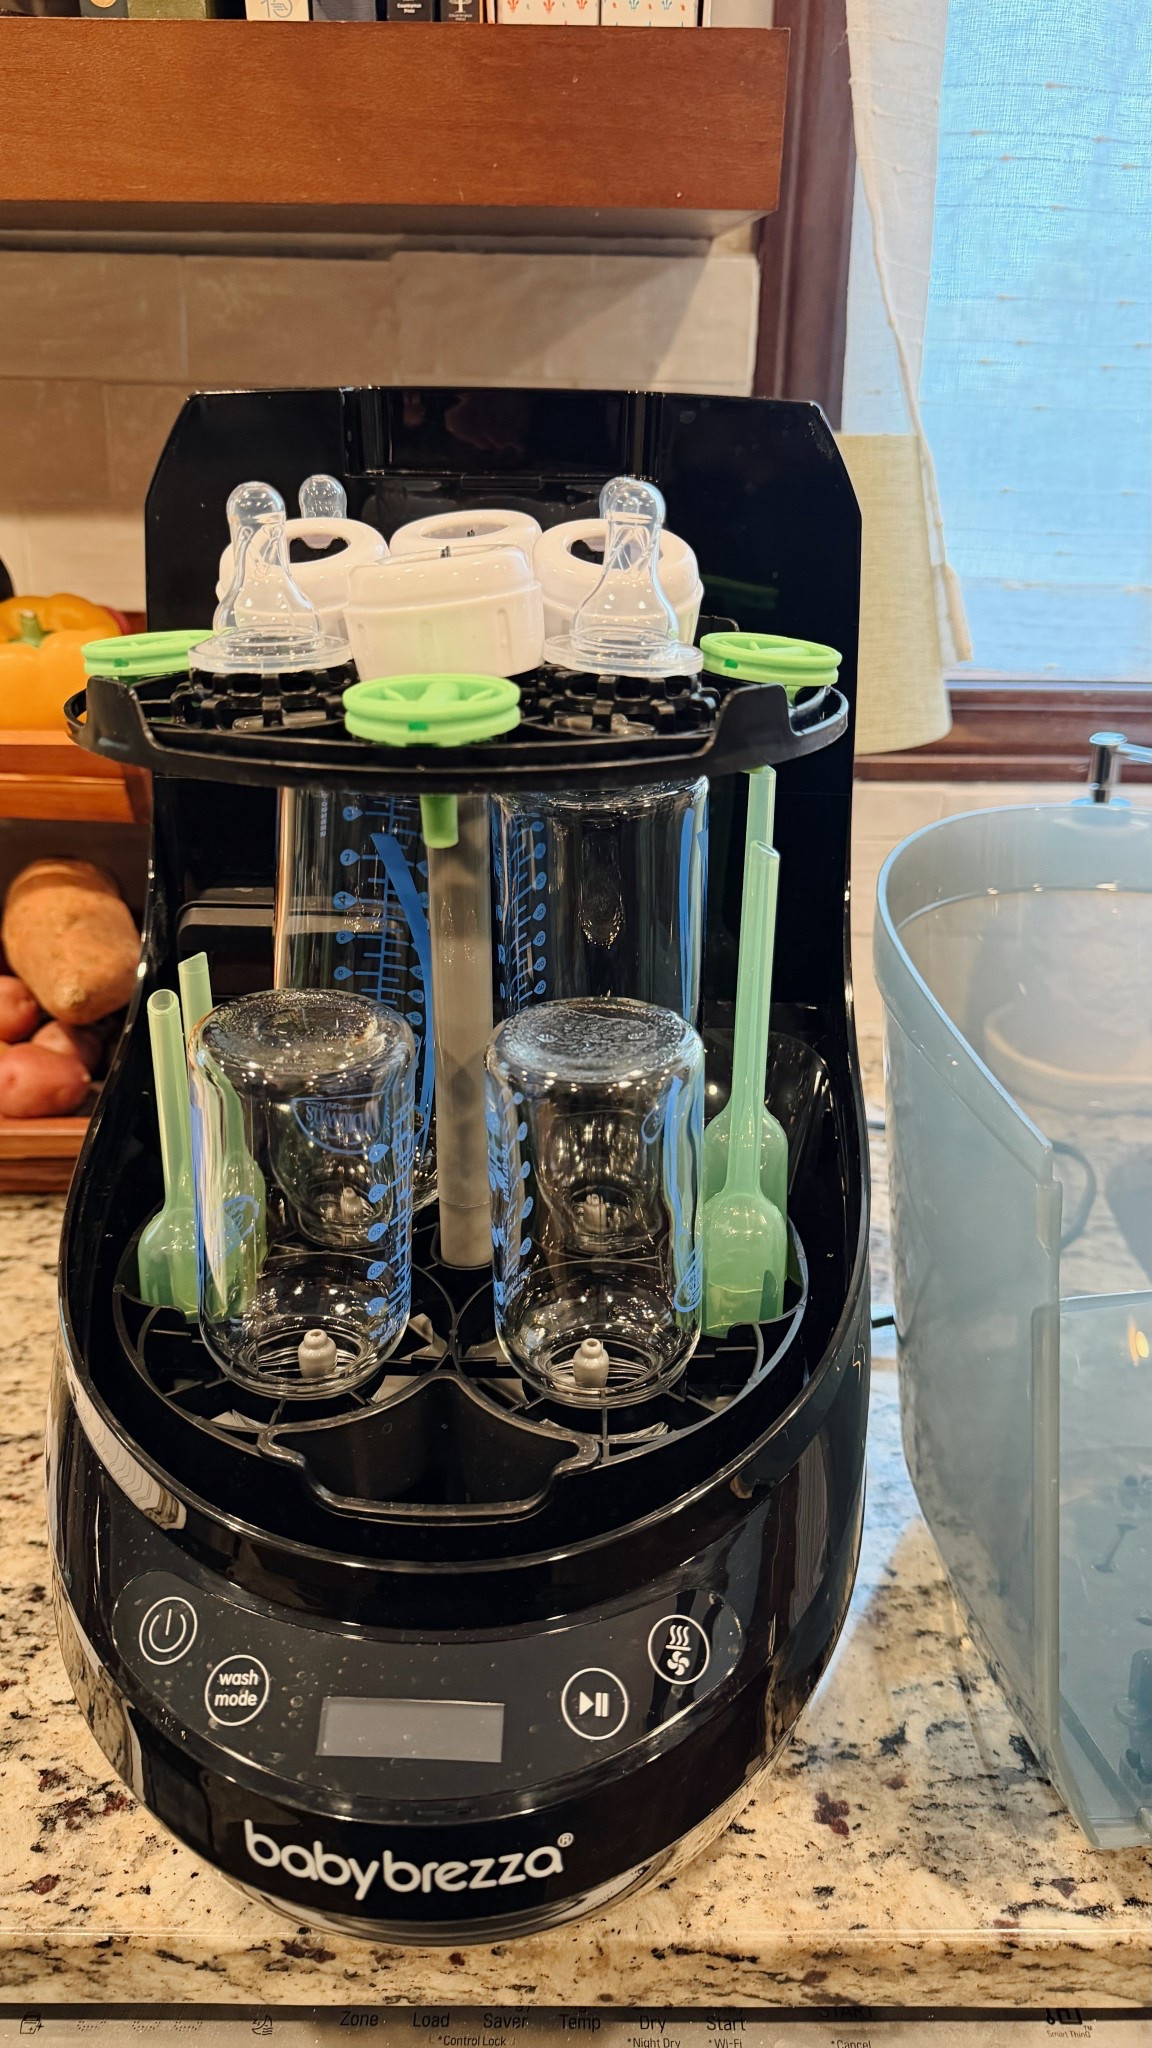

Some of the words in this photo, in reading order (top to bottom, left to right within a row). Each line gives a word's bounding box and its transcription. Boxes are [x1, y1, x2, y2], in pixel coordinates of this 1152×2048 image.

[218, 1668, 259, 1686] wash
[213, 1689, 258, 1707] mode
[339, 2011, 380, 2027] Zone
[412, 2012, 450, 2028] Load
[483, 2013, 528, 2029] Saver
[559, 2014, 601, 2033] Temp
[639, 2015, 666, 2034] Dry
[706, 2016, 746, 2031] Start
[482, 2035, 507, 2047] Lock
[663, 2037, 681, 2048] Dry
